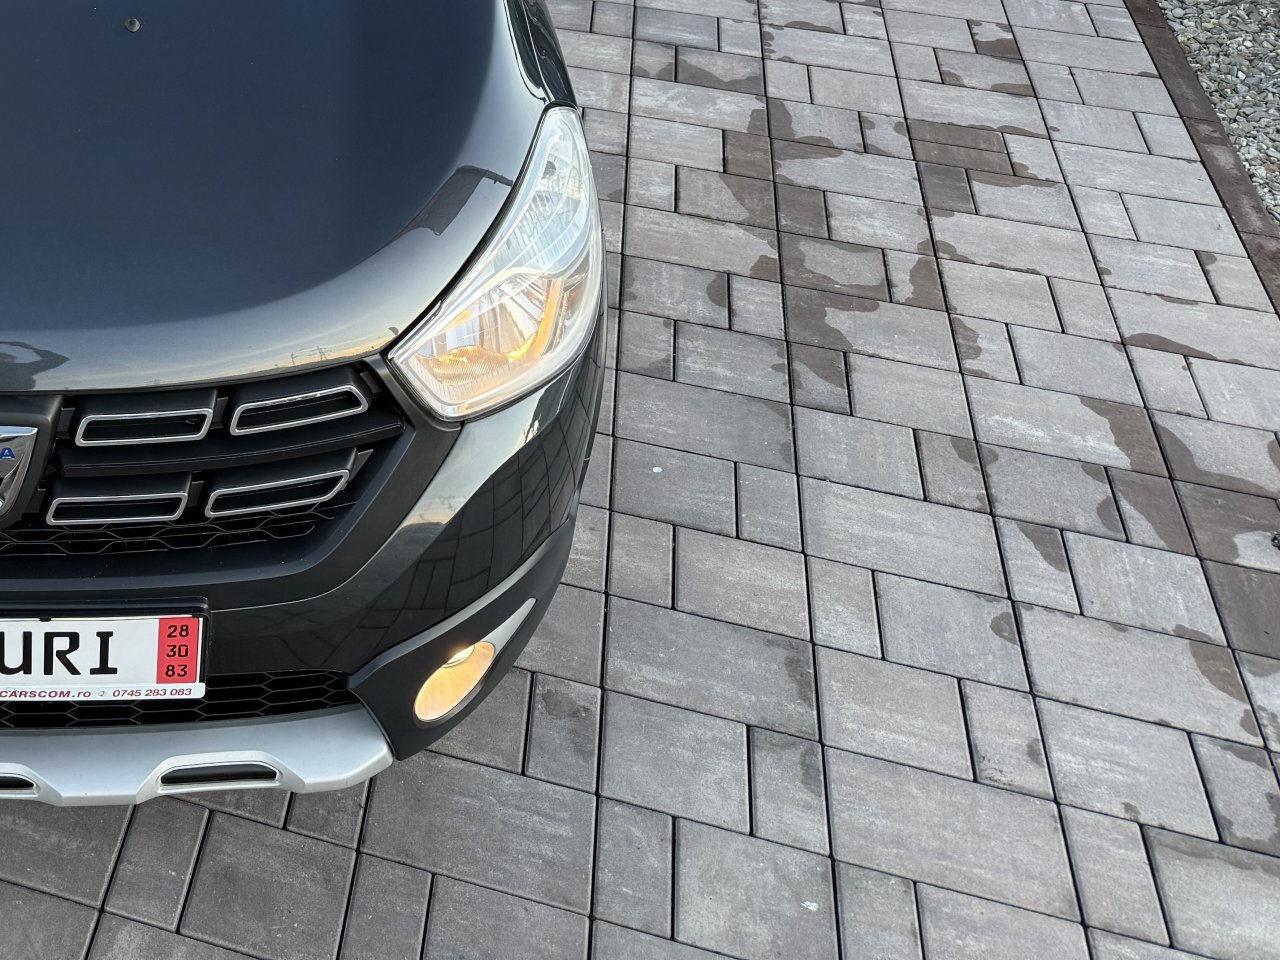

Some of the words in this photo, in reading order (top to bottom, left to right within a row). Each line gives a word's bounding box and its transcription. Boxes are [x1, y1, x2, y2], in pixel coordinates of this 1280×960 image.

[167, 624, 190, 638] 28
[166, 644, 189, 658] 30
[165, 664, 188, 677] 83
[113, 689, 142, 698] 0745
[144, 689, 167, 697] 283
[170, 688, 192, 697] 083
